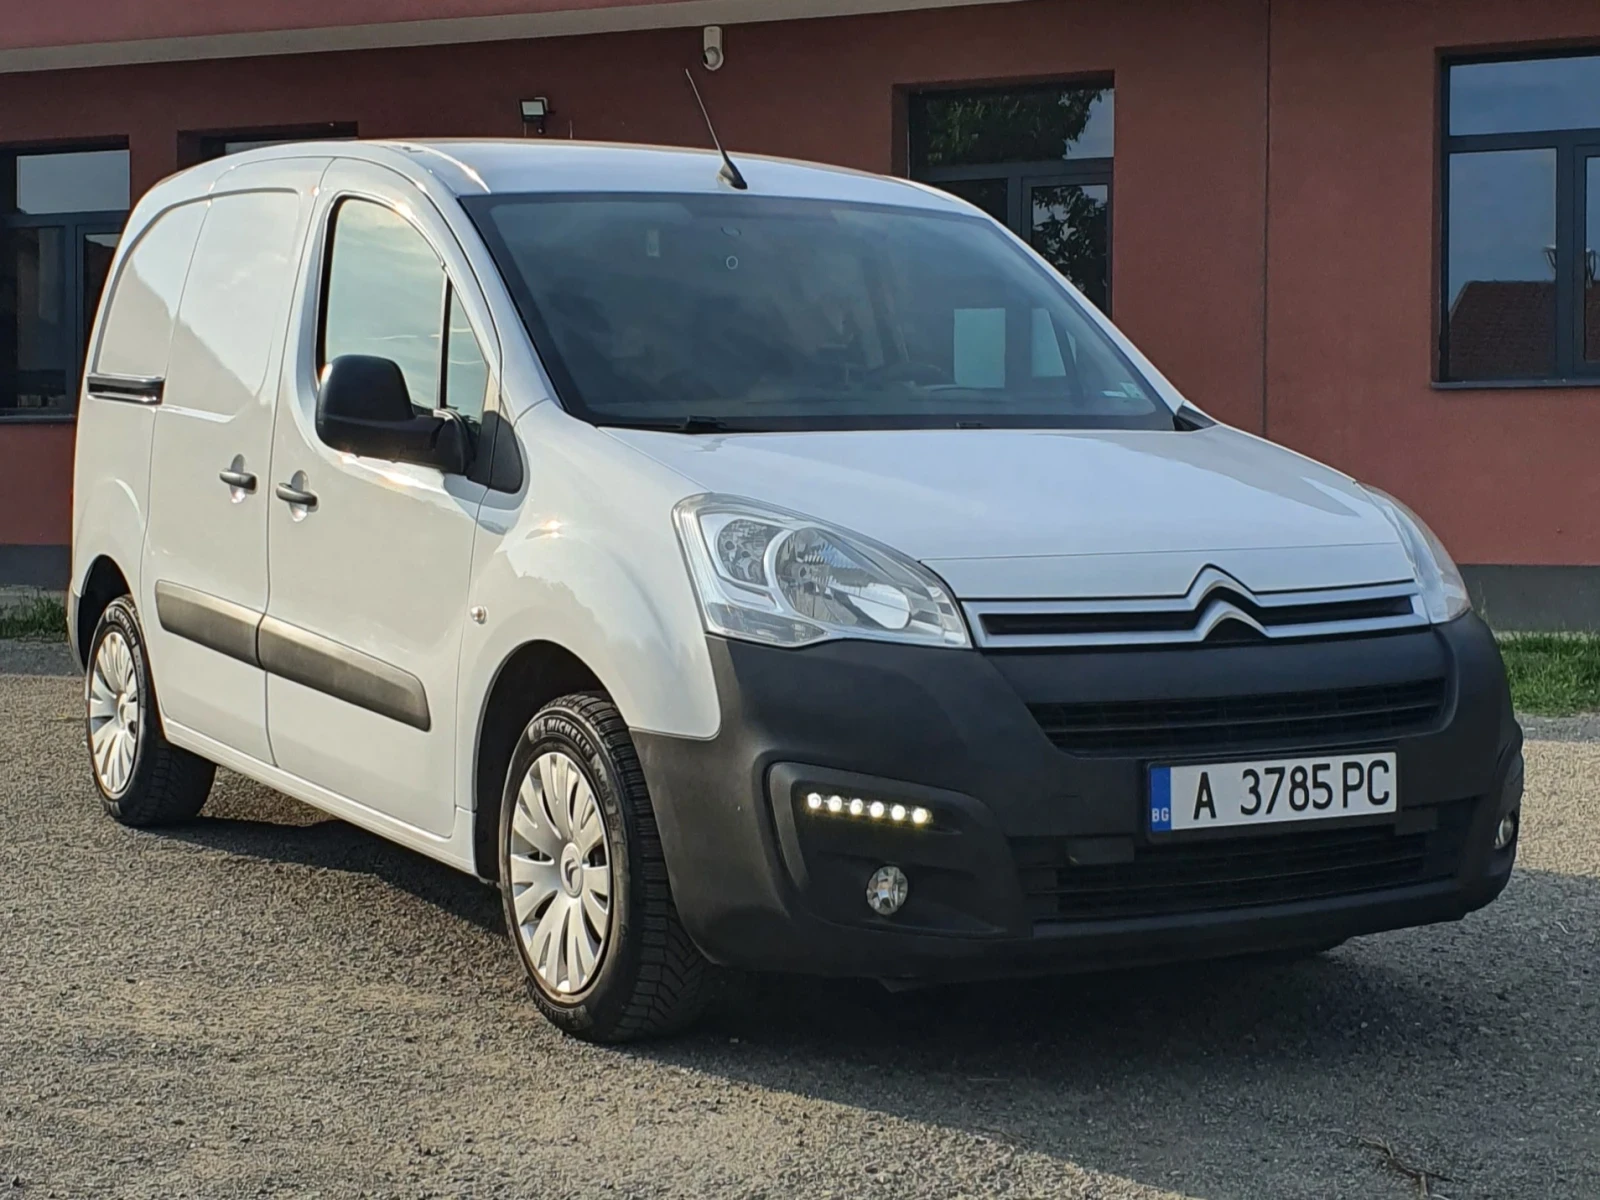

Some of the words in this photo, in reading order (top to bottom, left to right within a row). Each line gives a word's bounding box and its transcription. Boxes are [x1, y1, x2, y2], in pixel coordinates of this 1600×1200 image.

[547, 718, 593, 758] MICHELIN
[1151, 807, 1170, 823] BG
[1193, 771, 1217, 820] A
